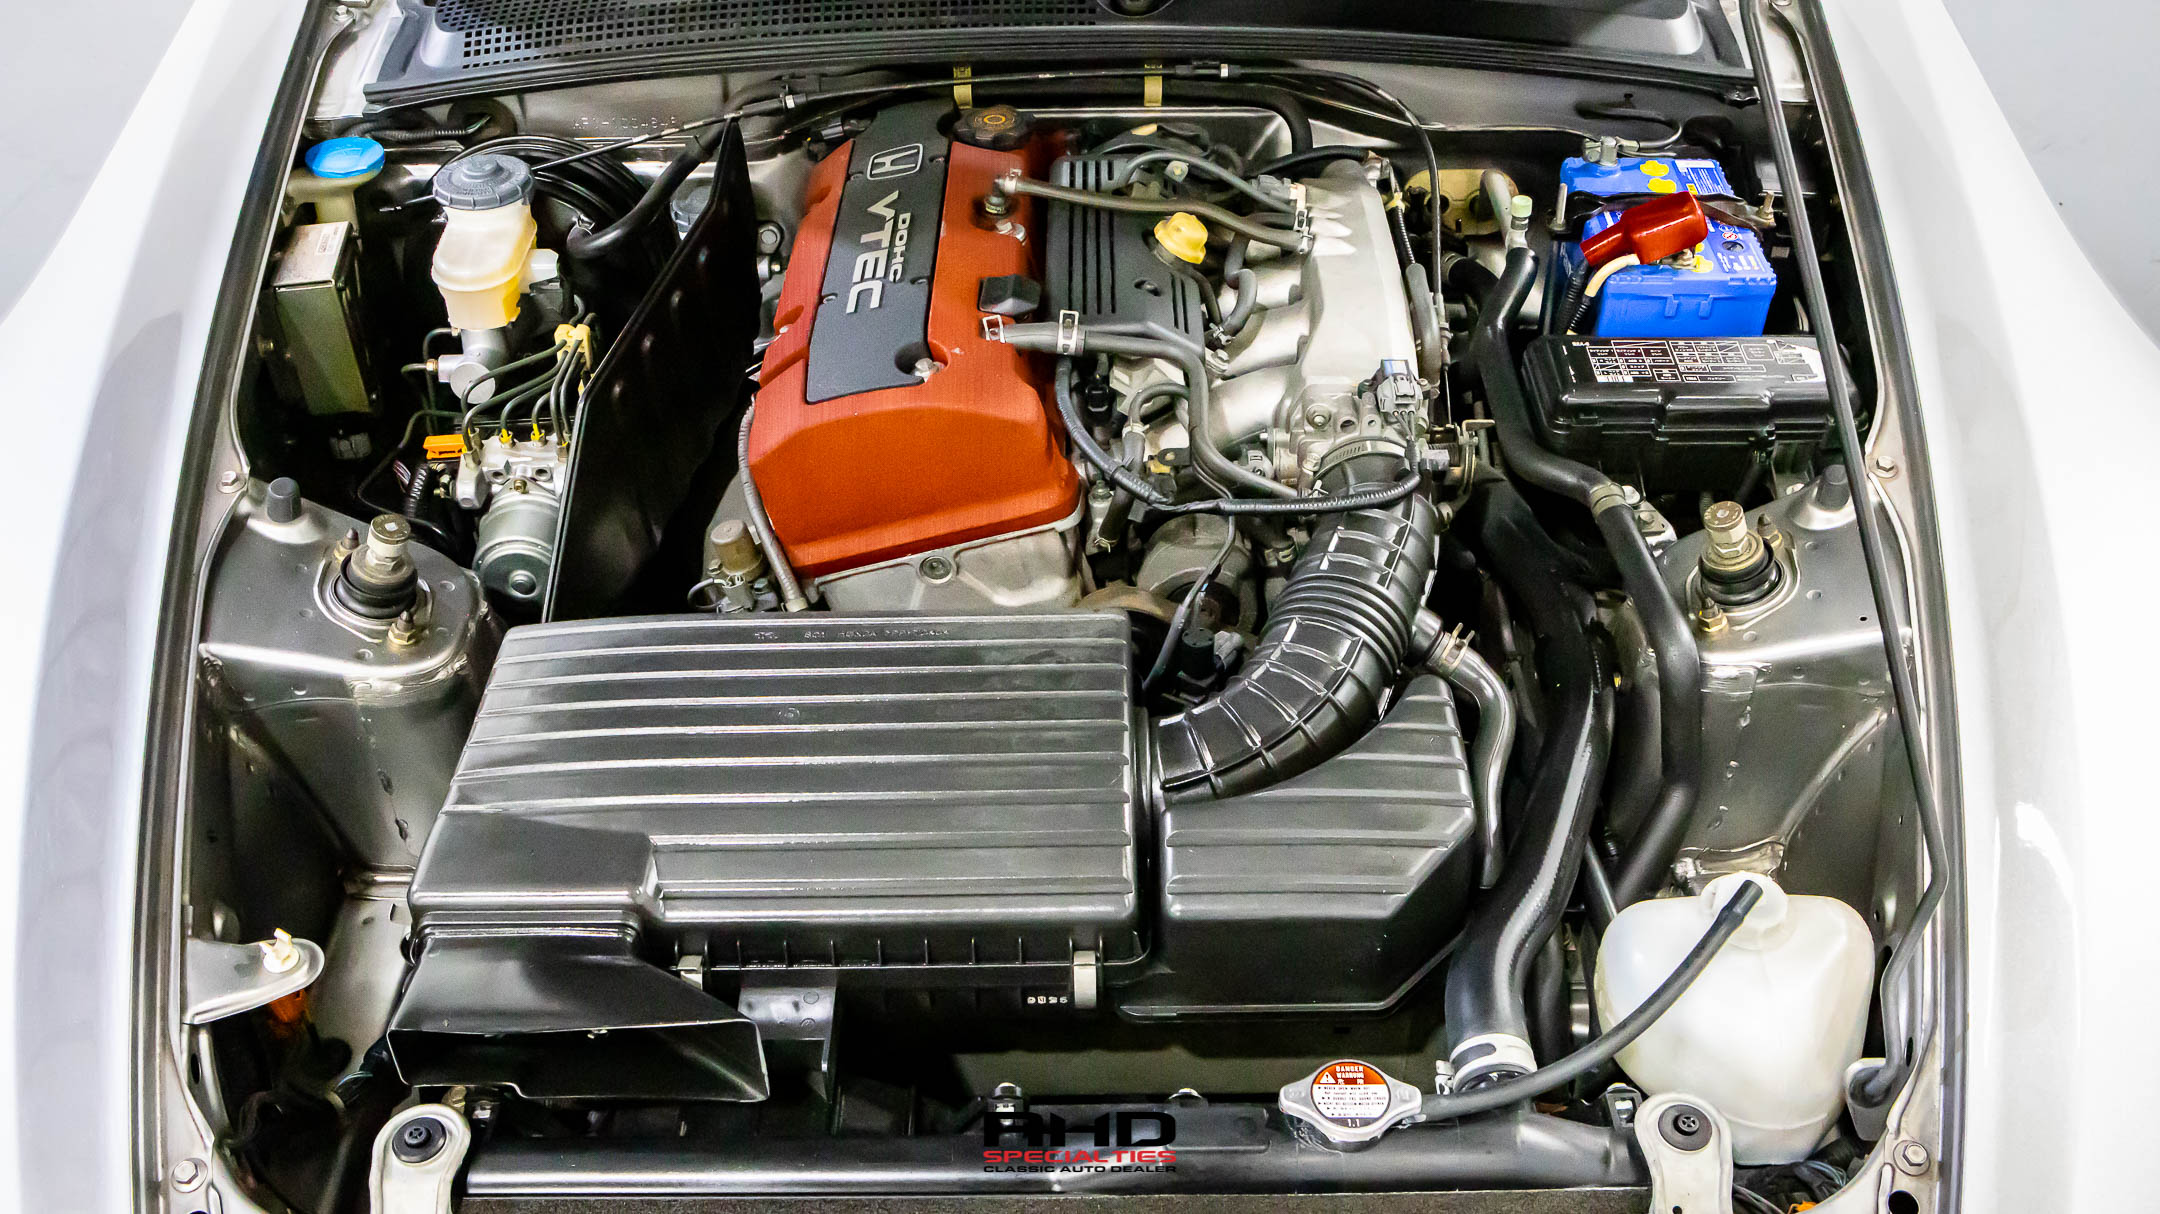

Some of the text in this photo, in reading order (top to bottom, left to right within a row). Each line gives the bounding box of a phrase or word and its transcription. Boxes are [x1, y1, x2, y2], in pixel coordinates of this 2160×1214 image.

[845, 189, 900, 314] VTEC
[888, 212, 911, 283] DOHC
[1347, 1118, 1361, 1128] 1.1
